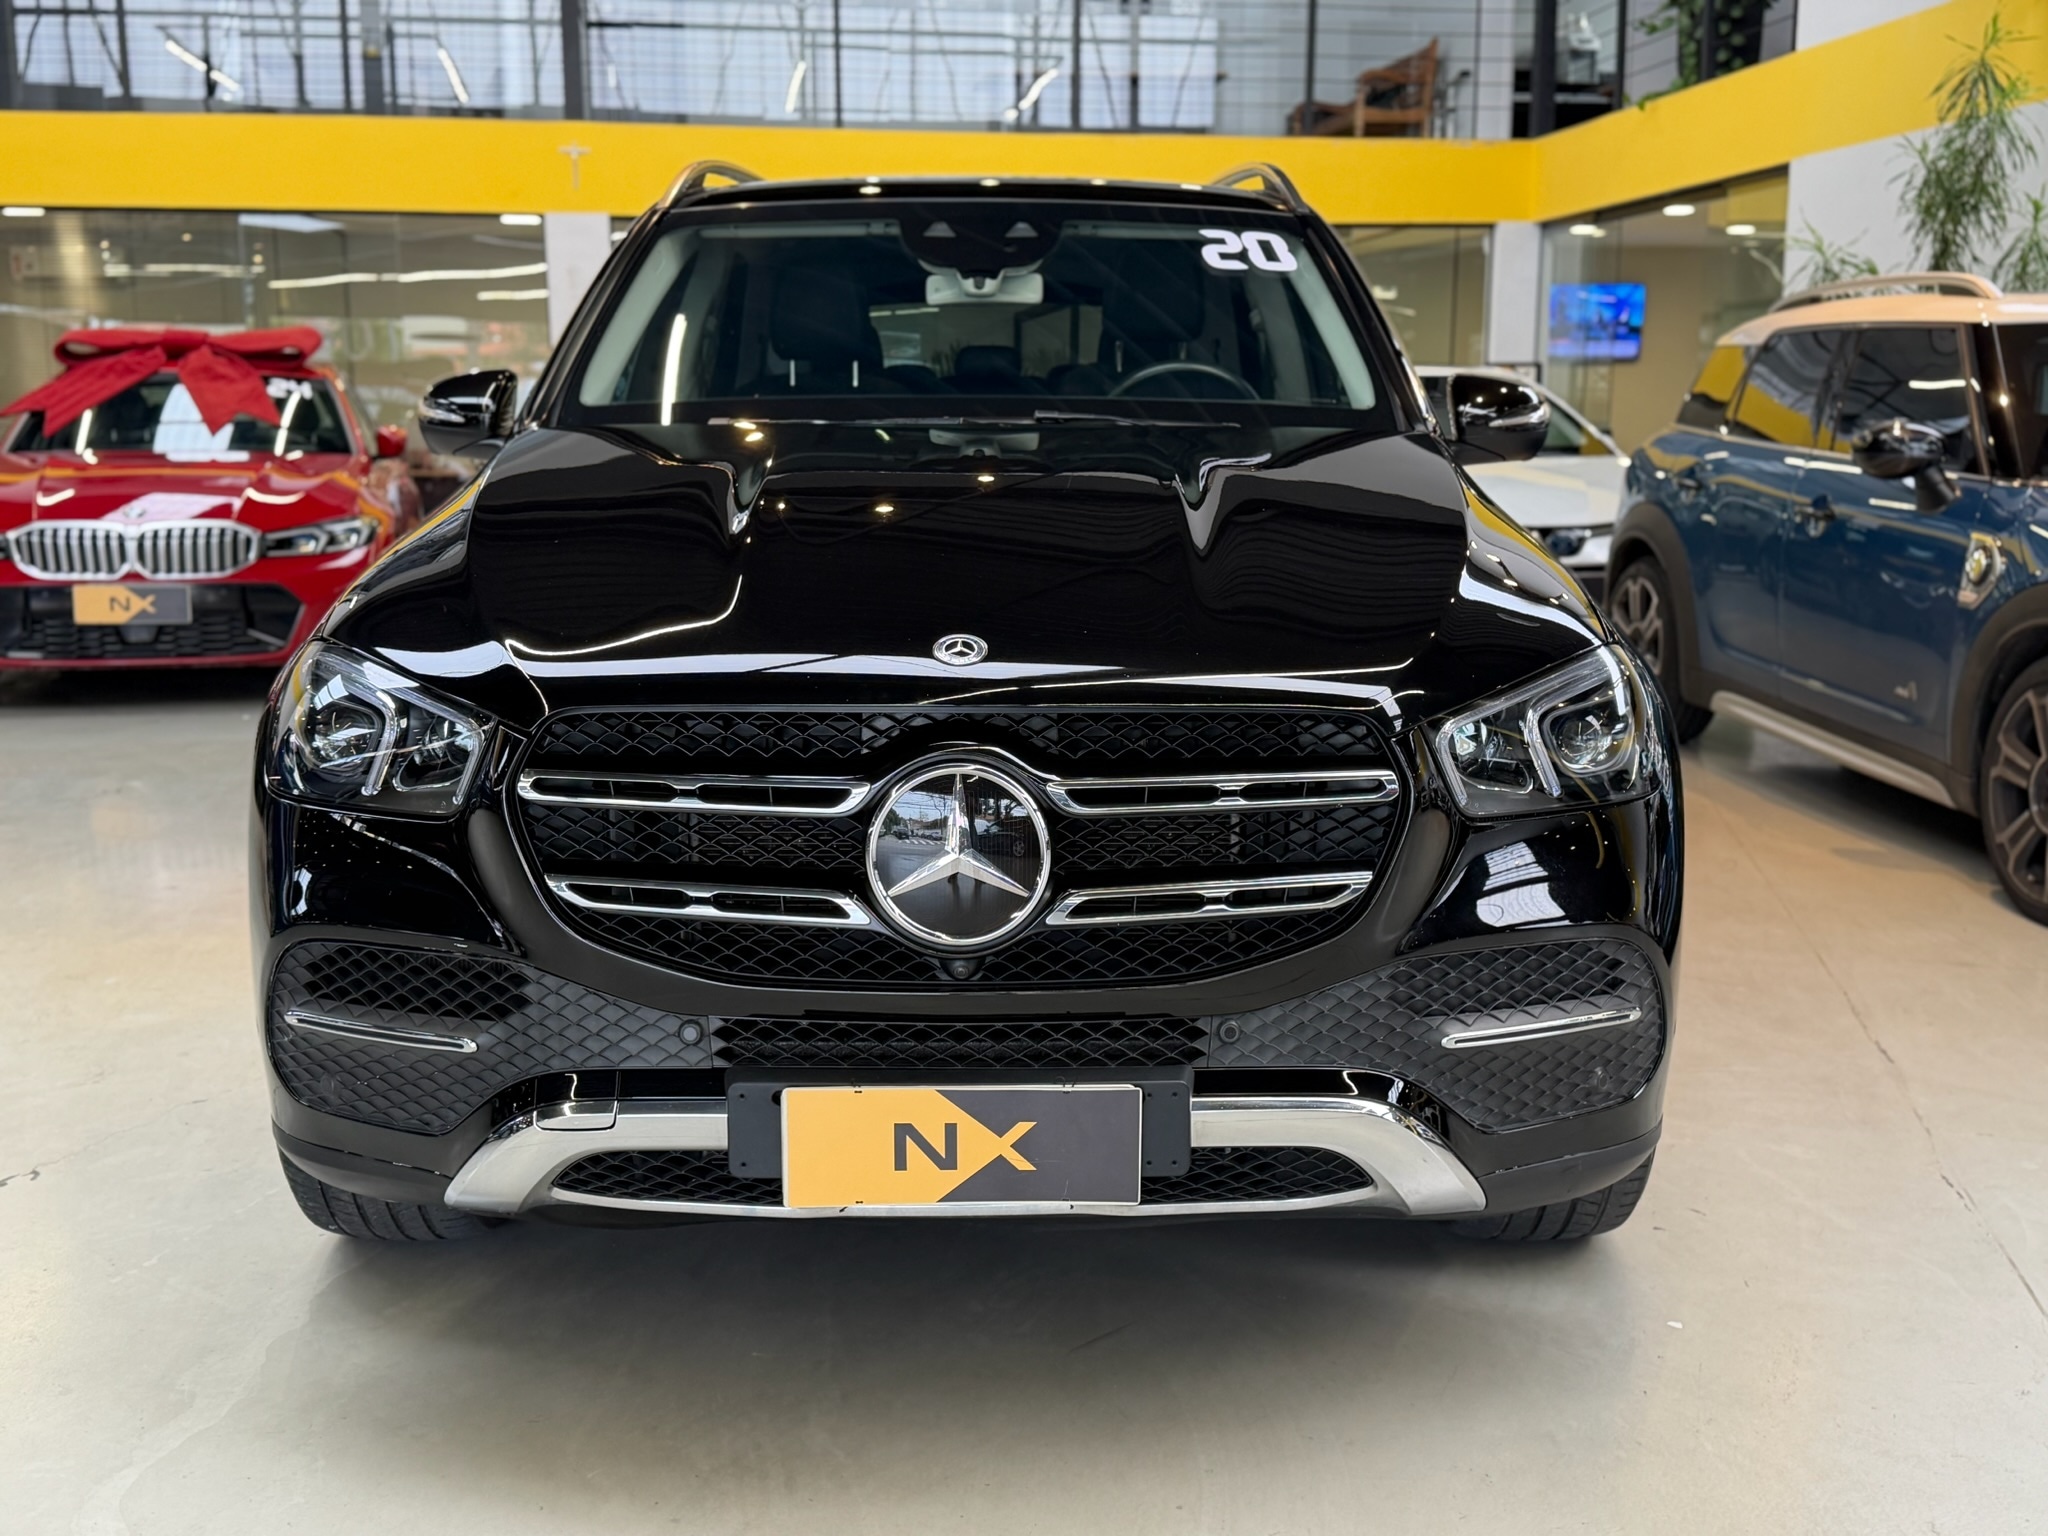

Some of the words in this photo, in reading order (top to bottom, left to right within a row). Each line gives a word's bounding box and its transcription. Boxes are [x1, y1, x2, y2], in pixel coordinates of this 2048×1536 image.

[1198, 229, 1297, 272] 20
[109, 594, 157, 615] NX
[893, 1121, 1038, 1172] NX
